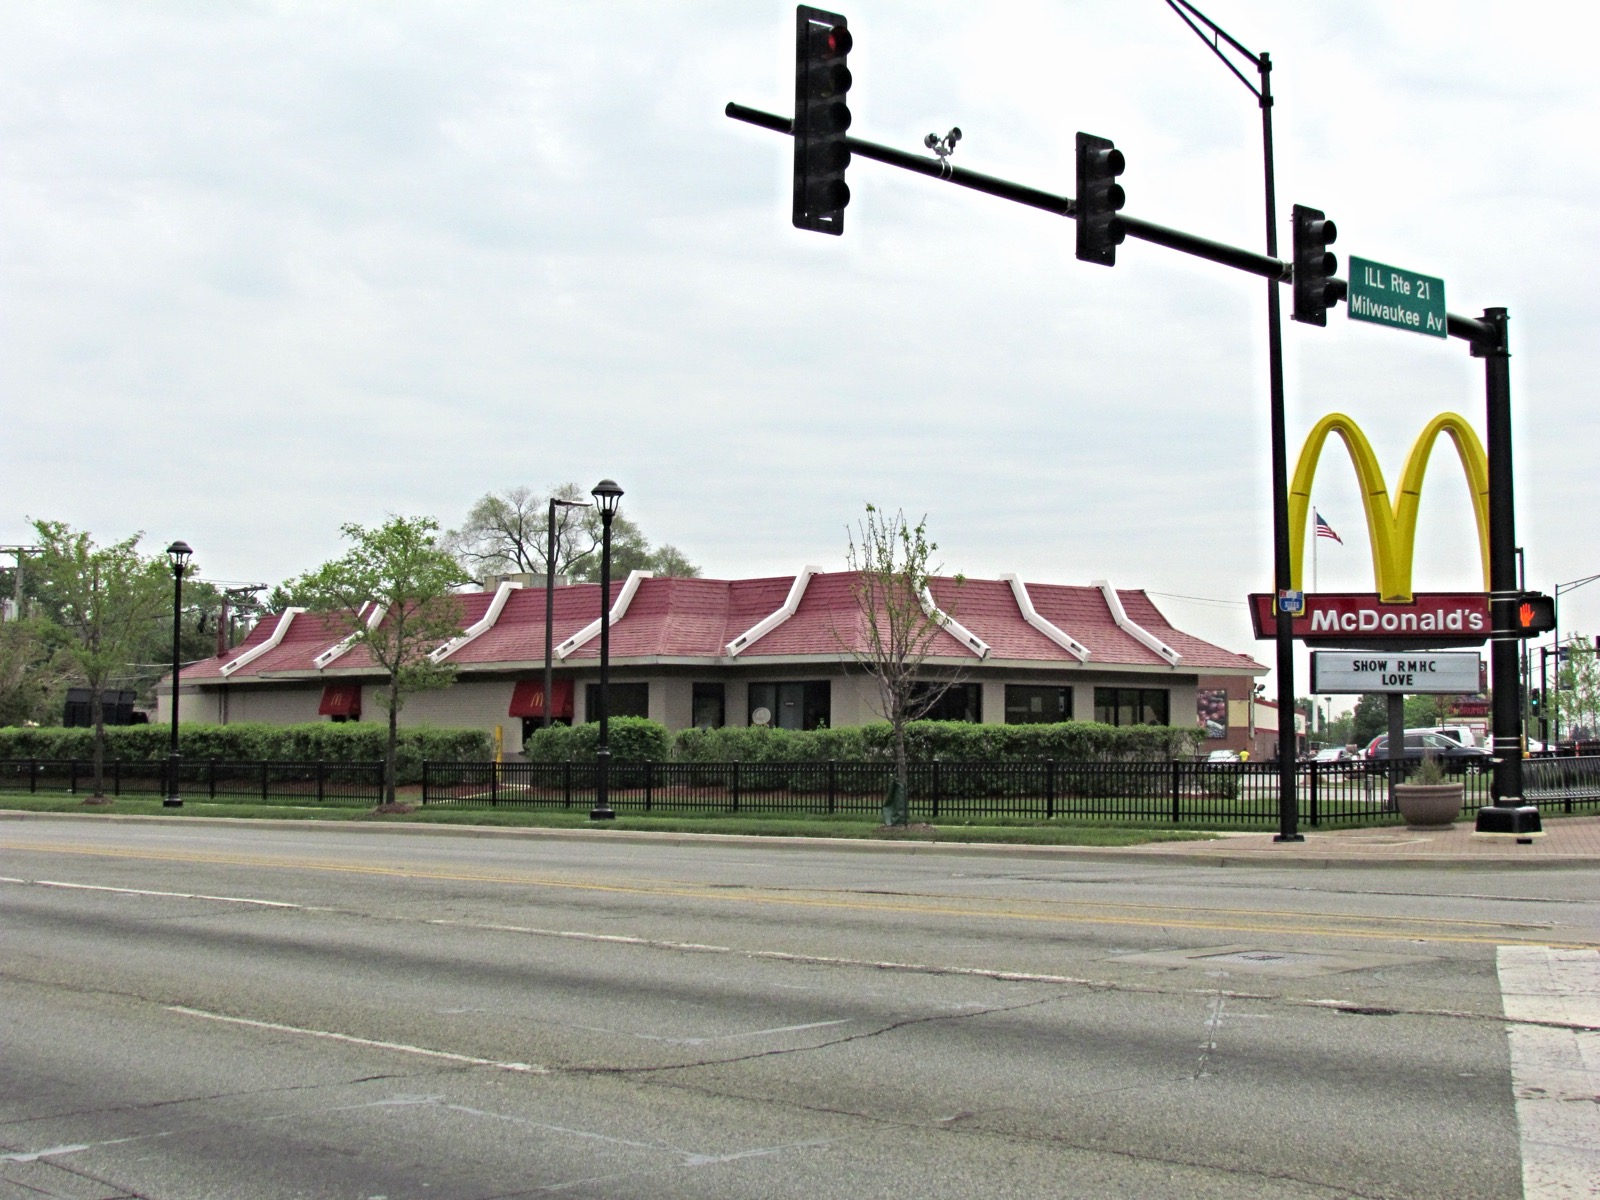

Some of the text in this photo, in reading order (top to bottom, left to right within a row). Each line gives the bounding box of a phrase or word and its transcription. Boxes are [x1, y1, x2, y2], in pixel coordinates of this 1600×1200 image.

[1365, 266, 1430, 300] ILL Rte 21
[1351, 293, 1443, 332] Milwaukee Av
[1311, 609, 1483, 631] McDonald's
[1353, 660, 1436, 672] SHOW RMHC
[1382, 674, 1413, 686] LOVE
